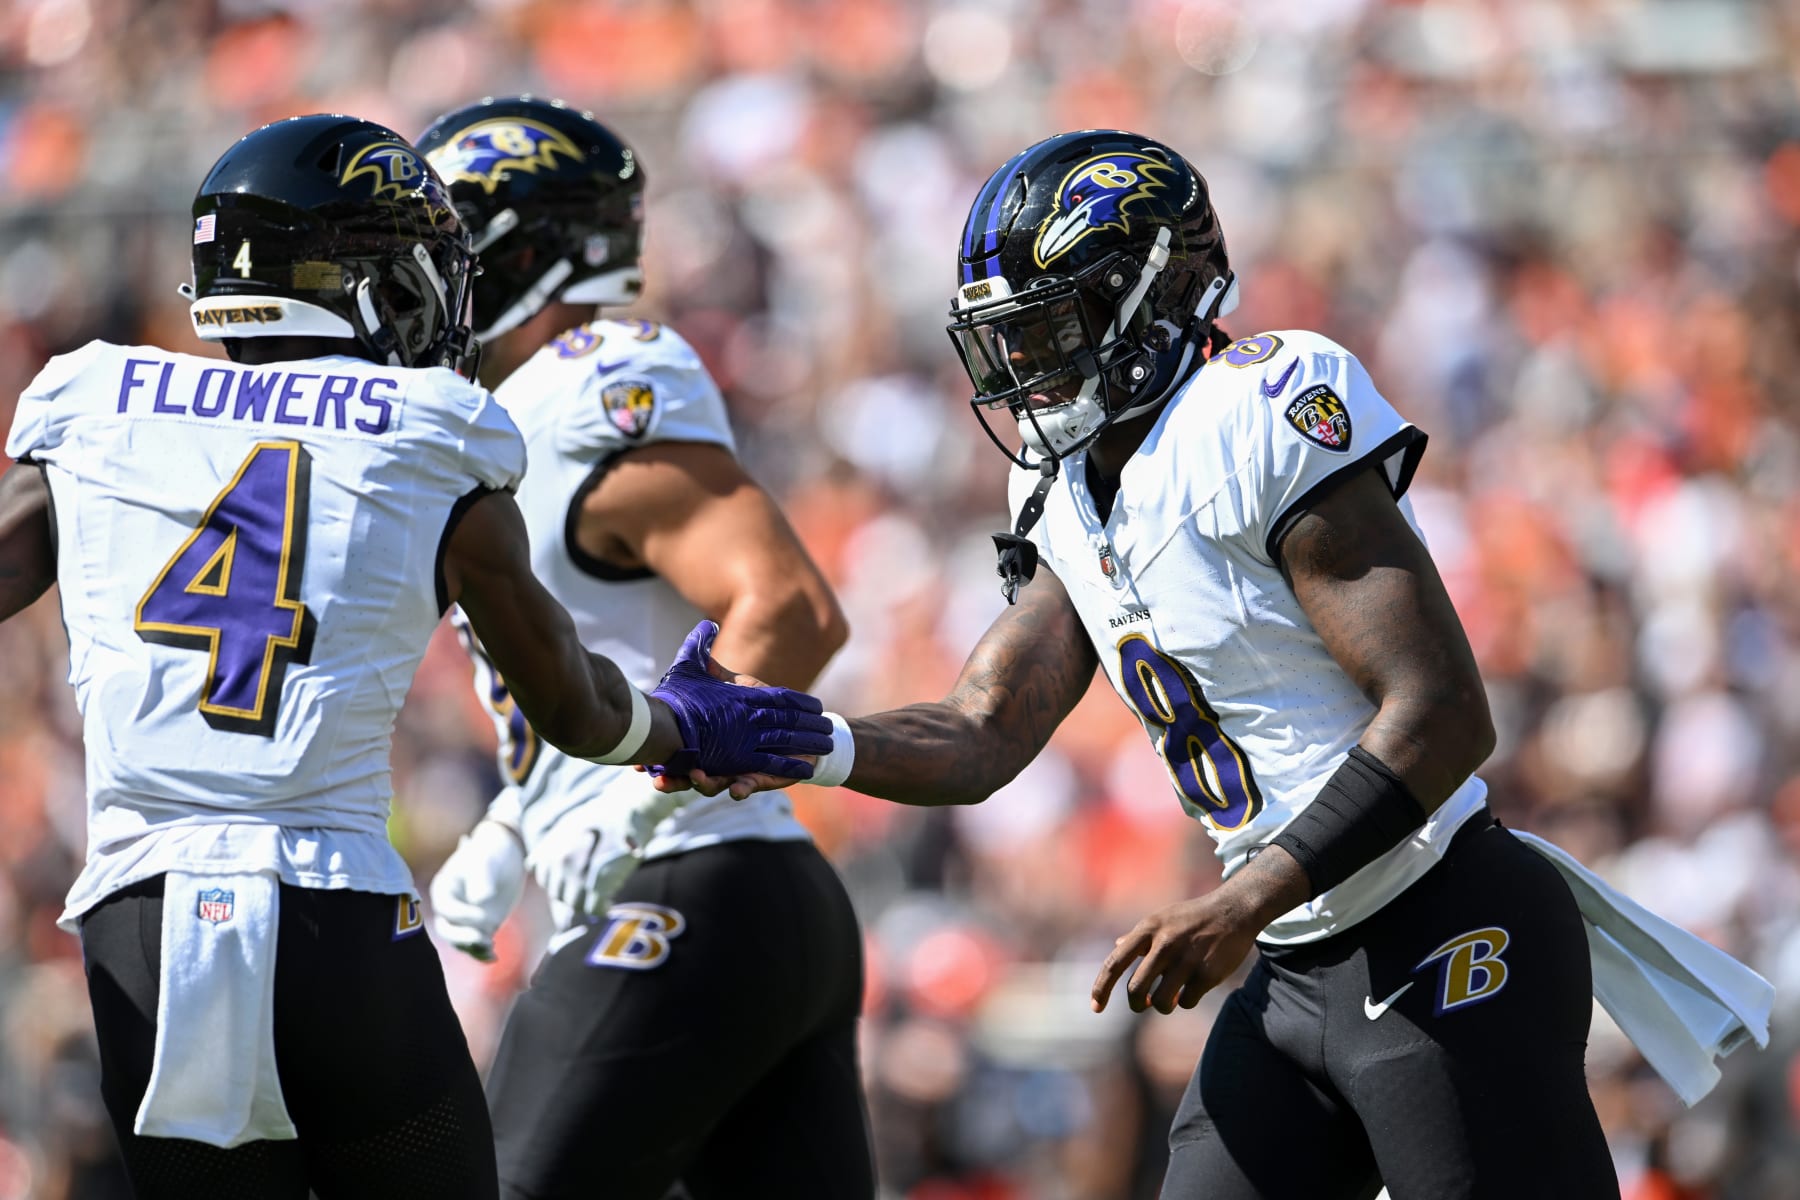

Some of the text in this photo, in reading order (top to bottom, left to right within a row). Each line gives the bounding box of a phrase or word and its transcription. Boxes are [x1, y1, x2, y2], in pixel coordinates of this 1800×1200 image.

[369, 148, 420, 182] B
[1068, 162, 1138, 189] B
[232, 241, 252, 279] 4
[193, 304, 284, 327] RAVENS
[117, 358, 398, 436] FLOWERS
[1288, 385, 1328, 418] RAVENS
[133, 440, 319, 738] 4
[1109, 608, 1152, 629] RAVENS
[1116, 632, 1264, 832] 8
[201, 902, 230, 921] NFL
[584, 901, 686, 970] B
[1408, 924, 1511, 1019] B
